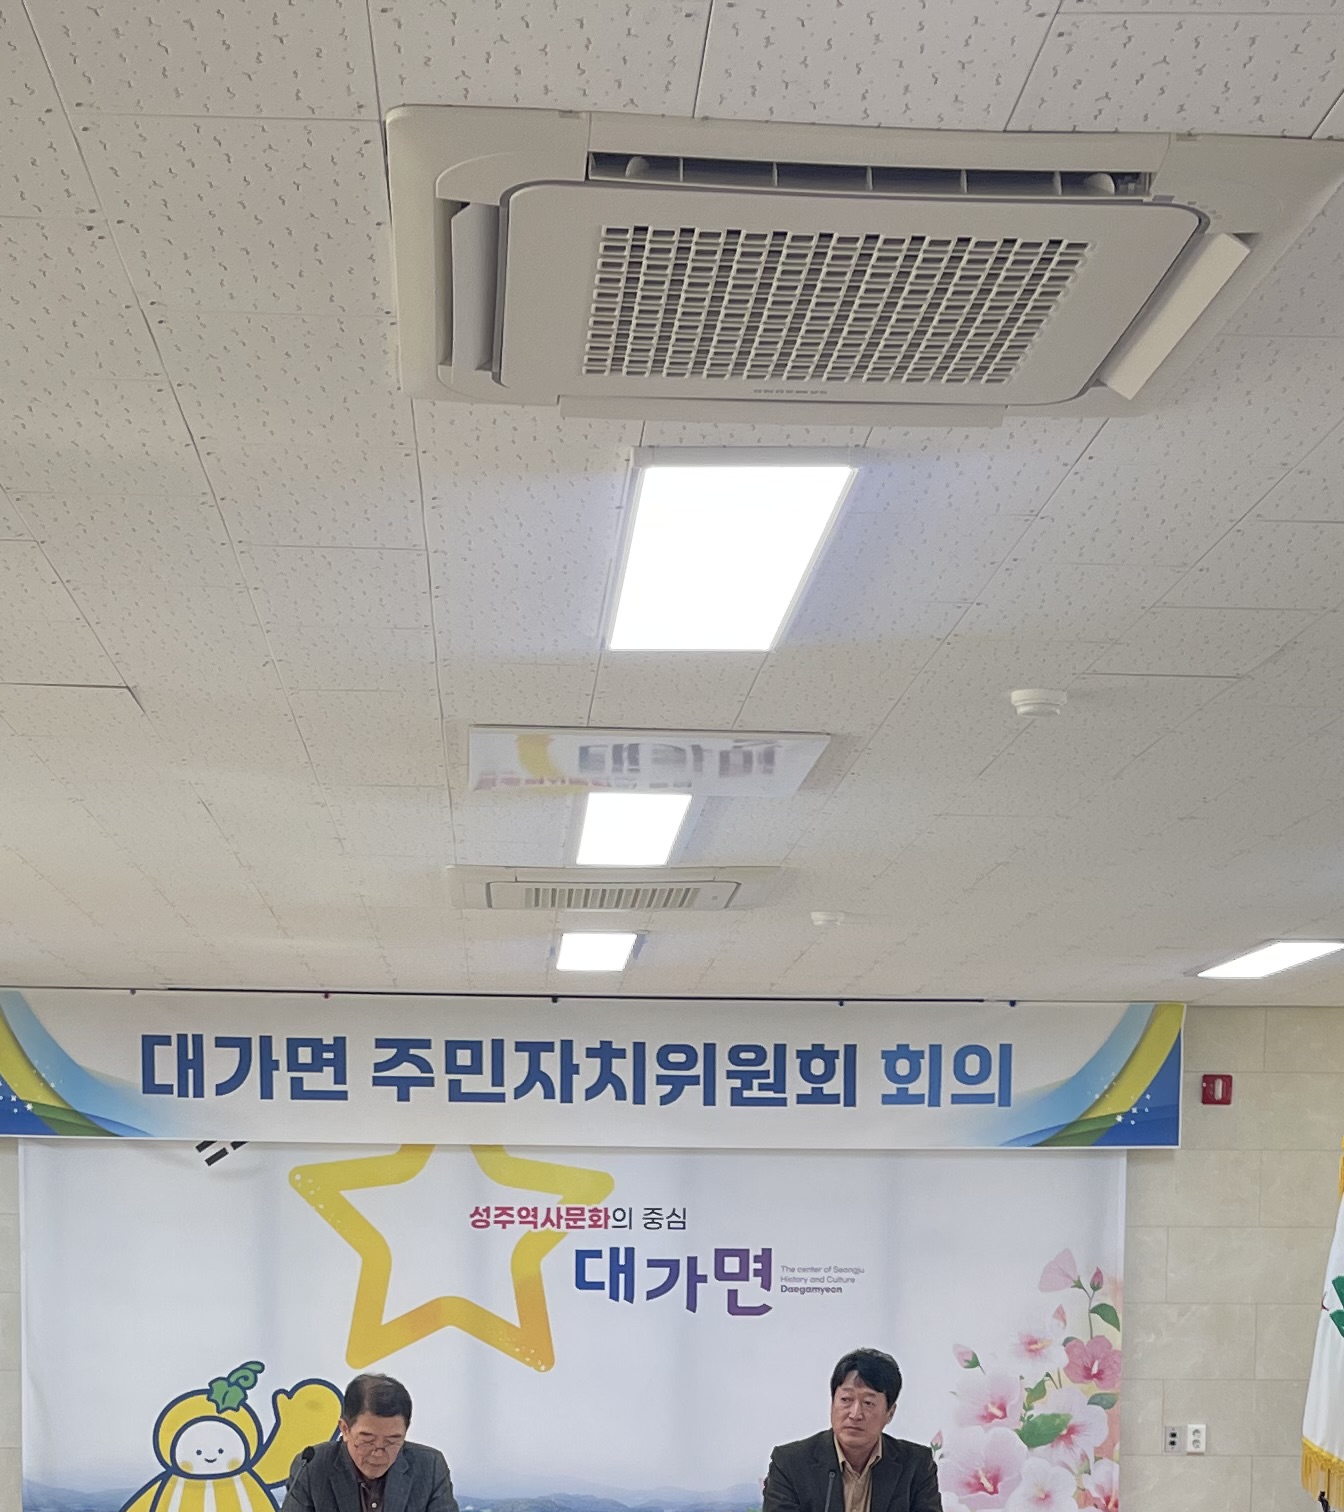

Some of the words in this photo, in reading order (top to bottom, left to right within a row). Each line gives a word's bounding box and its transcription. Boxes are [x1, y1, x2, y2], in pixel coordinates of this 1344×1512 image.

[141, 1033, 349, 1101] 대가면
[372, 1037, 858, 1108] 주민자치위원회
[880, 1043, 1013, 1108] 회의
[469, 1205, 633, 1231] 성주역사문화의
[642, 1206, 687, 1231] 중심
[780, 1265, 796, 1274] The
[797, 1265, 822, 1274] center
[823, 1265, 832, 1274] of
[833, 1265, 865, 1276] Seongju
[574, 1246, 773, 1317] 대가면
[780, 1276, 808, 1285] History
[809, 1275, 825, 1284] and
[826, 1276, 856, 1284] Culture
[780, 1284, 843, 1295] Daegamyeon
